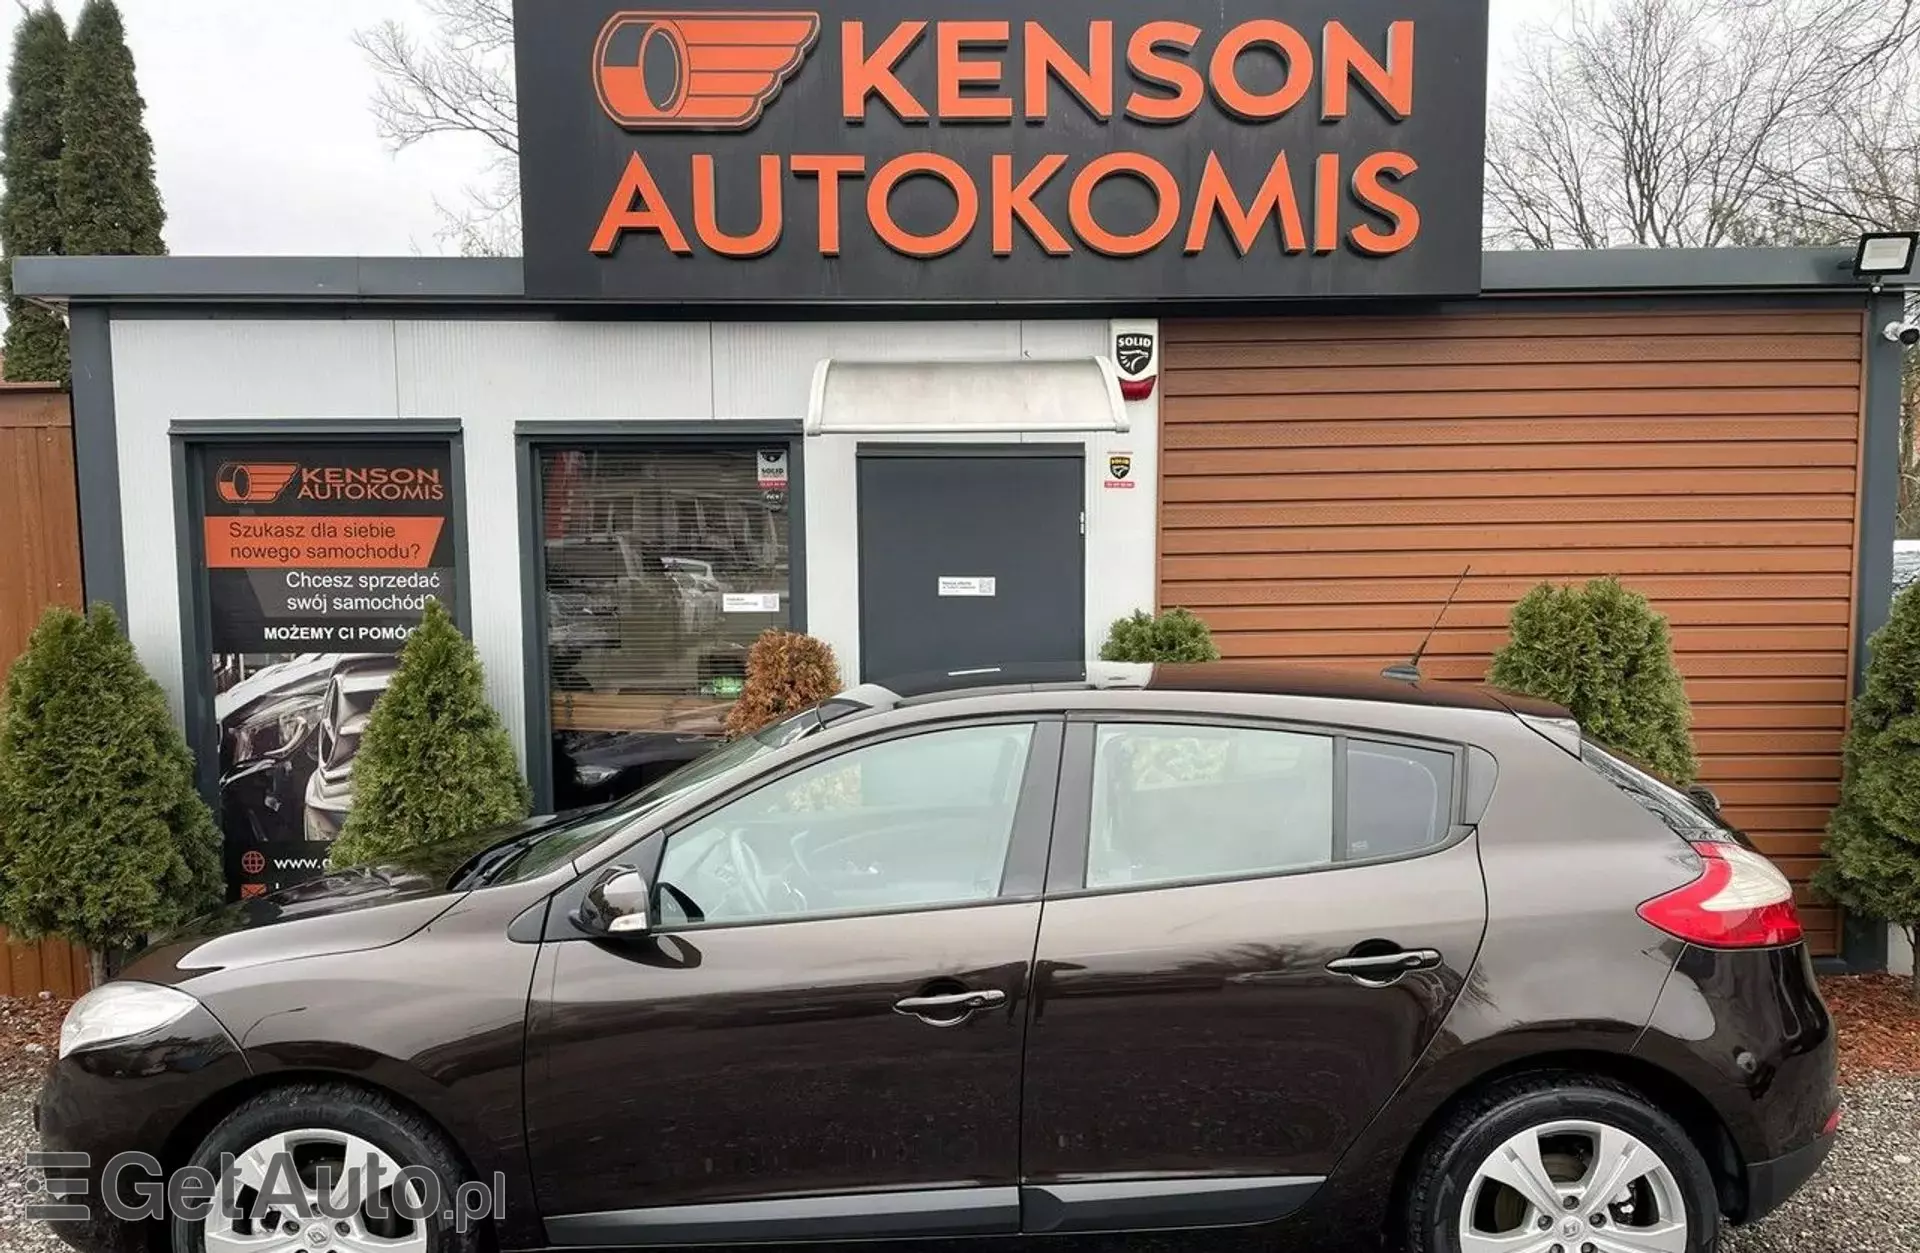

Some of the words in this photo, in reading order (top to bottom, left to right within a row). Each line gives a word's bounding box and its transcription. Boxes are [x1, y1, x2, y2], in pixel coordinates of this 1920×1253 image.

[841, 20, 1414, 124] KENSON
[589, 150, 1420, 258] AUTOKOMIS
[1118, 337, 1151, 347] SOLID
[302, 468, 439, 484] KENSON
[297, 484, 444, 500] AUTOKOMIS
[229, 522, 305, 538] Szukasz
[311, 521, 337, 538] dla
[343, 521, 396, 538] siebie
[230, 546, 301, 562] nowego
[306, 543, 420, 560] samochodu?
[286, 571, 353, 588] Chcesz
[358, 572, 440, 591] sprzedać
[287, 594, 327, 614] swój
[264, 624, 334, 640] MOŻEMY
[338, 627, 354, 640] CI
